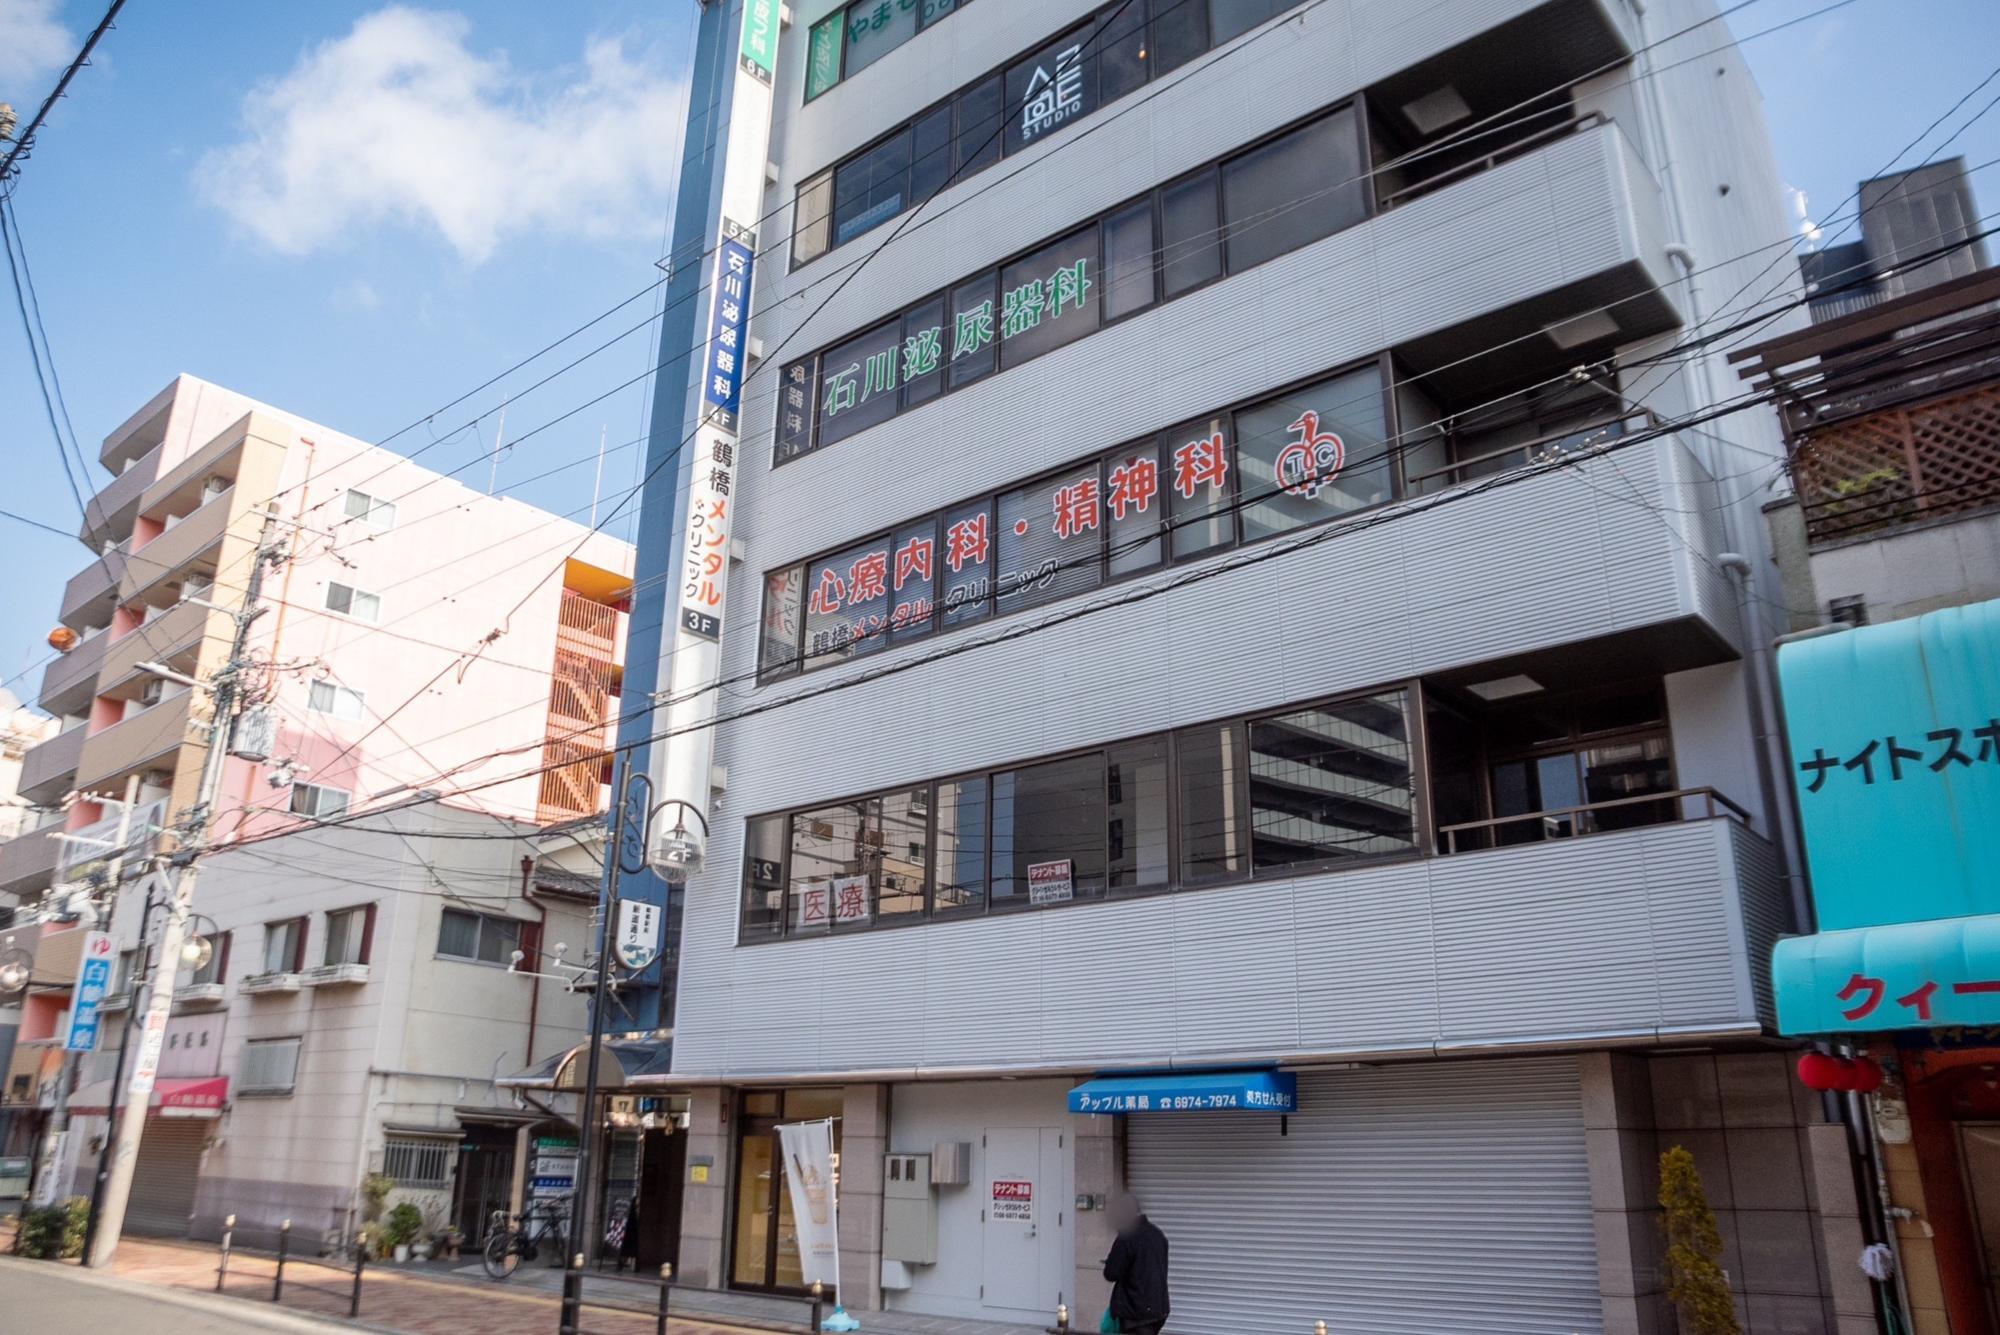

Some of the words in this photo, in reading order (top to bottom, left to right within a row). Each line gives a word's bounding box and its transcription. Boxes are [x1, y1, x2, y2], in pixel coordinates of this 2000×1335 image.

[747, 59, 765, 79] 6F
[1023, 100, 1080, 139] STUDIO
[728, 222, 748, 242] 5F
[713, 250, 745, 399] 石川泌尿器科
[823, 257, 1093, 416] 石川泌尿器科
[709, 406, 731, 427] 4F
[808, 431, 1228, 615] 心療内科・精神科
[685, 513, 705, 599] クリニック
[688, 611, 711, 632] 3F
[804, 883, 866, 921] 医療
[1080, 1094, 1149, 1110] アップル薬局
[1174, 1095, 1237, 1109] 6974-7974
